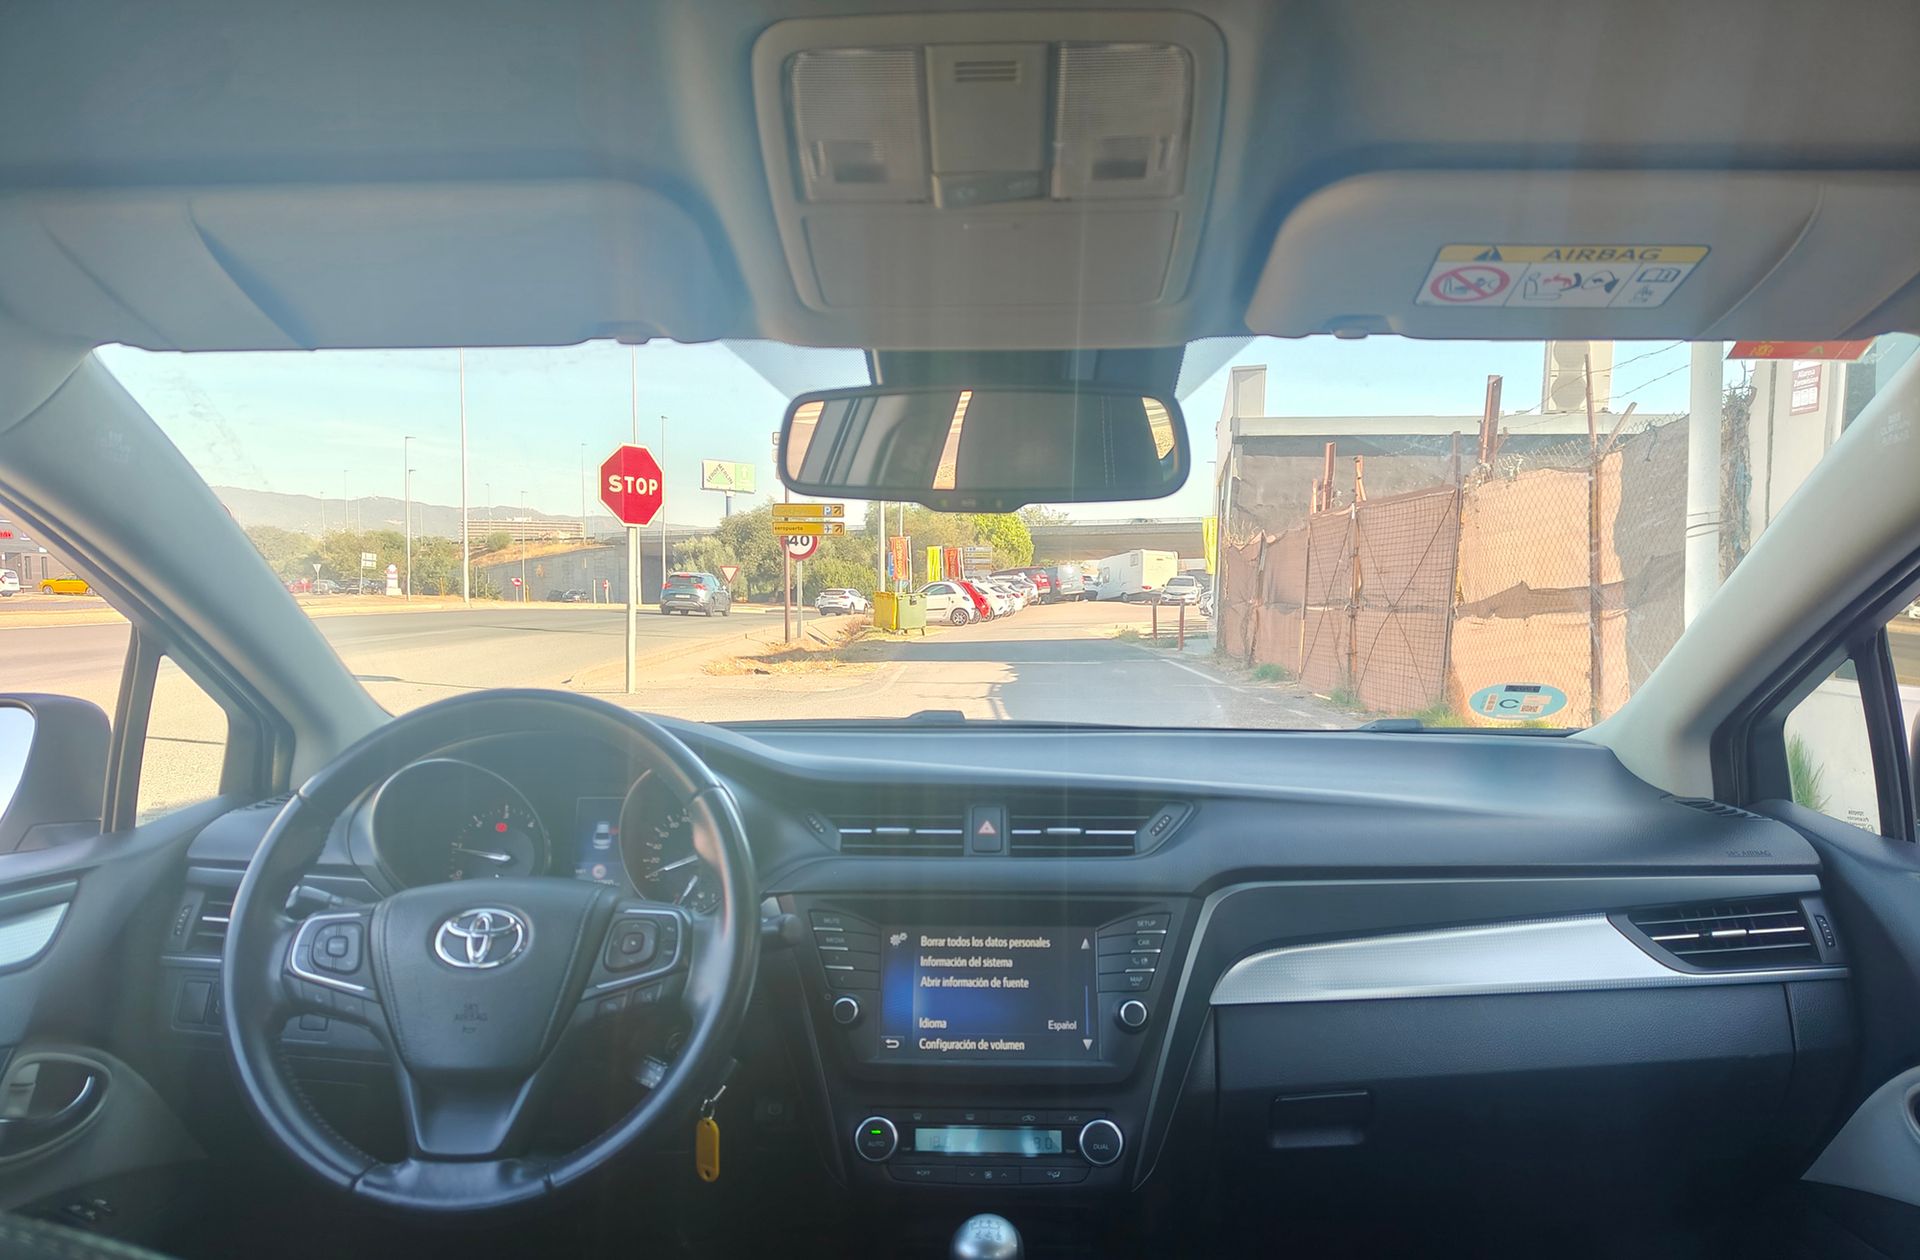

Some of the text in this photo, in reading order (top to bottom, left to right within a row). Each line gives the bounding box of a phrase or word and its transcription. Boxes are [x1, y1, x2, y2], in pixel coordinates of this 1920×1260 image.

[1543, 248, 1661, 261] AIRBAG
[608, 475, 659, 495] STOP
[788, 535, 810, 546] 40
[920, 936, 1051, 949] Borrar todos los datos personales
[920, 956, 1013, 968] Información del sistema
[920, 976, 1029, 989] Abrir información de fuente
[919, 1017, 947, 1029] Idioma
[1048, 1020, 1077, 1031] Español
[919, 1038, 1025, 1052] Configuración de volumen
